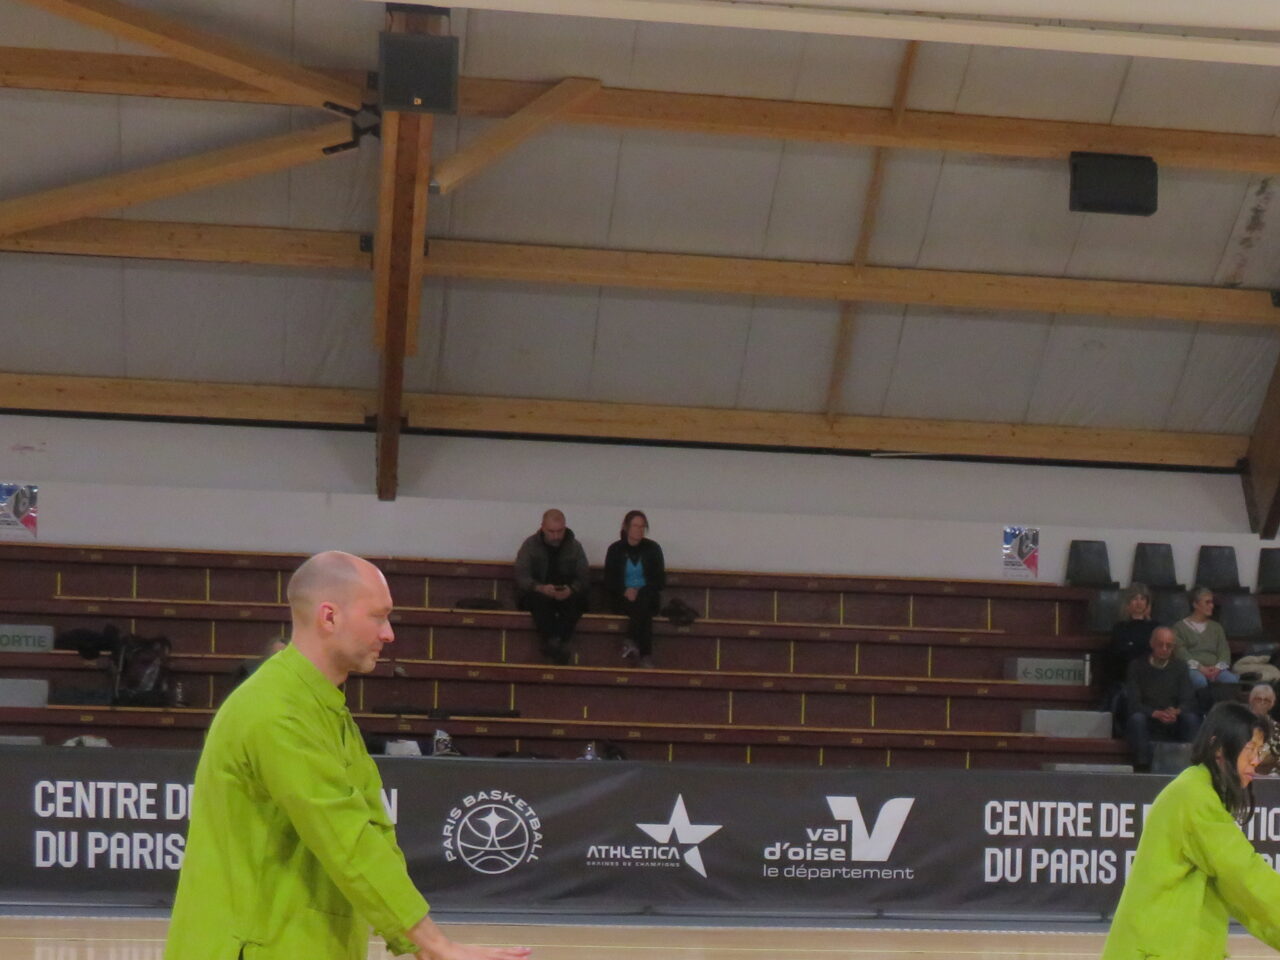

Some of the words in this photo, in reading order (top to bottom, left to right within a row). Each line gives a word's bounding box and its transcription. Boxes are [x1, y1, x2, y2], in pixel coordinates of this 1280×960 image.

[35, 781, 157, 819] CENTRE
[442, 806, 463, 862] PARIS
[462, 789, 544, 864] BASKETBALL
[806, 824, 846, 844] val
[985, 801, 1093, 836] CENTRE
[1100, 803, 1135, 837] DE
[36, 831, 78, 867] DU
[87, 832, 186, 870] PARIS
[585, 844, 681, 860] ATHLETICA
[985, 848, 1022, 882] DU
[1031, 849, 1116, 884] PARIS
[764, 864, 778, 877] le
[784, 865, 914, 880] département
